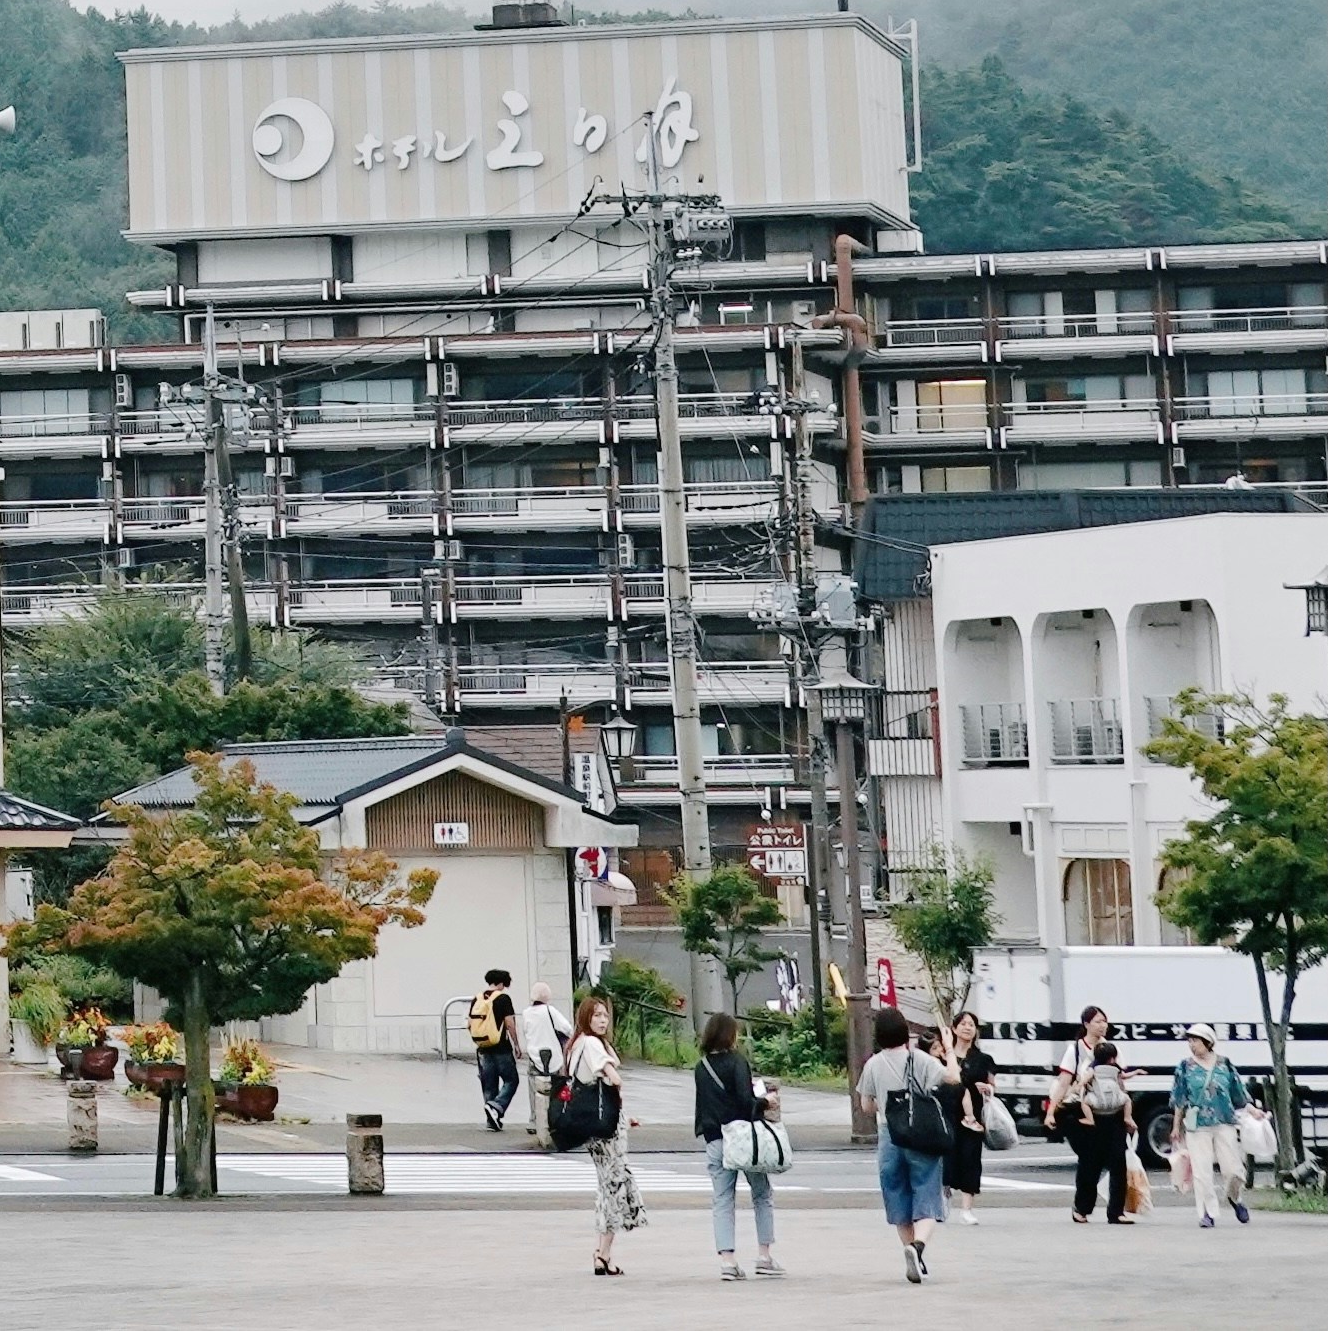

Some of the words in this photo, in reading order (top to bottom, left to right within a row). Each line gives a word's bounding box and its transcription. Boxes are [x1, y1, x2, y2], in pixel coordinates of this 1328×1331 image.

[749, 834, 803, 846] 公衆トイレ
